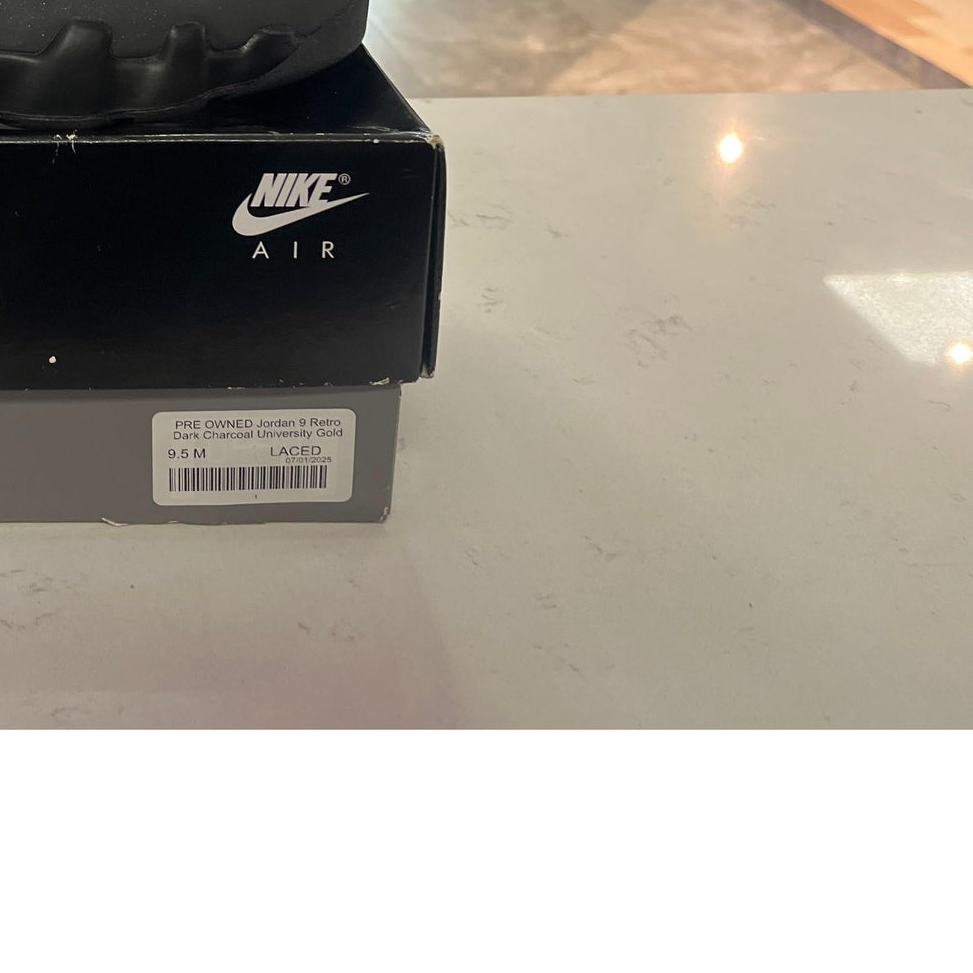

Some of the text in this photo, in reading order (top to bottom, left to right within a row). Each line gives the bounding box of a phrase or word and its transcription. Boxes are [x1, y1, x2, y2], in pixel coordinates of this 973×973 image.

[250, 172, 338, 207] NIKE
[251, 240, 334, 259] AIR
[175, 417, 341, 429] PRE OWNED Jordan 9 Retro
[173, 428, 343, 440] Dark Charcoal University Gold
[167, 448, 206, 459] 9.5 M
[270, 446, 322, 457] LACED
